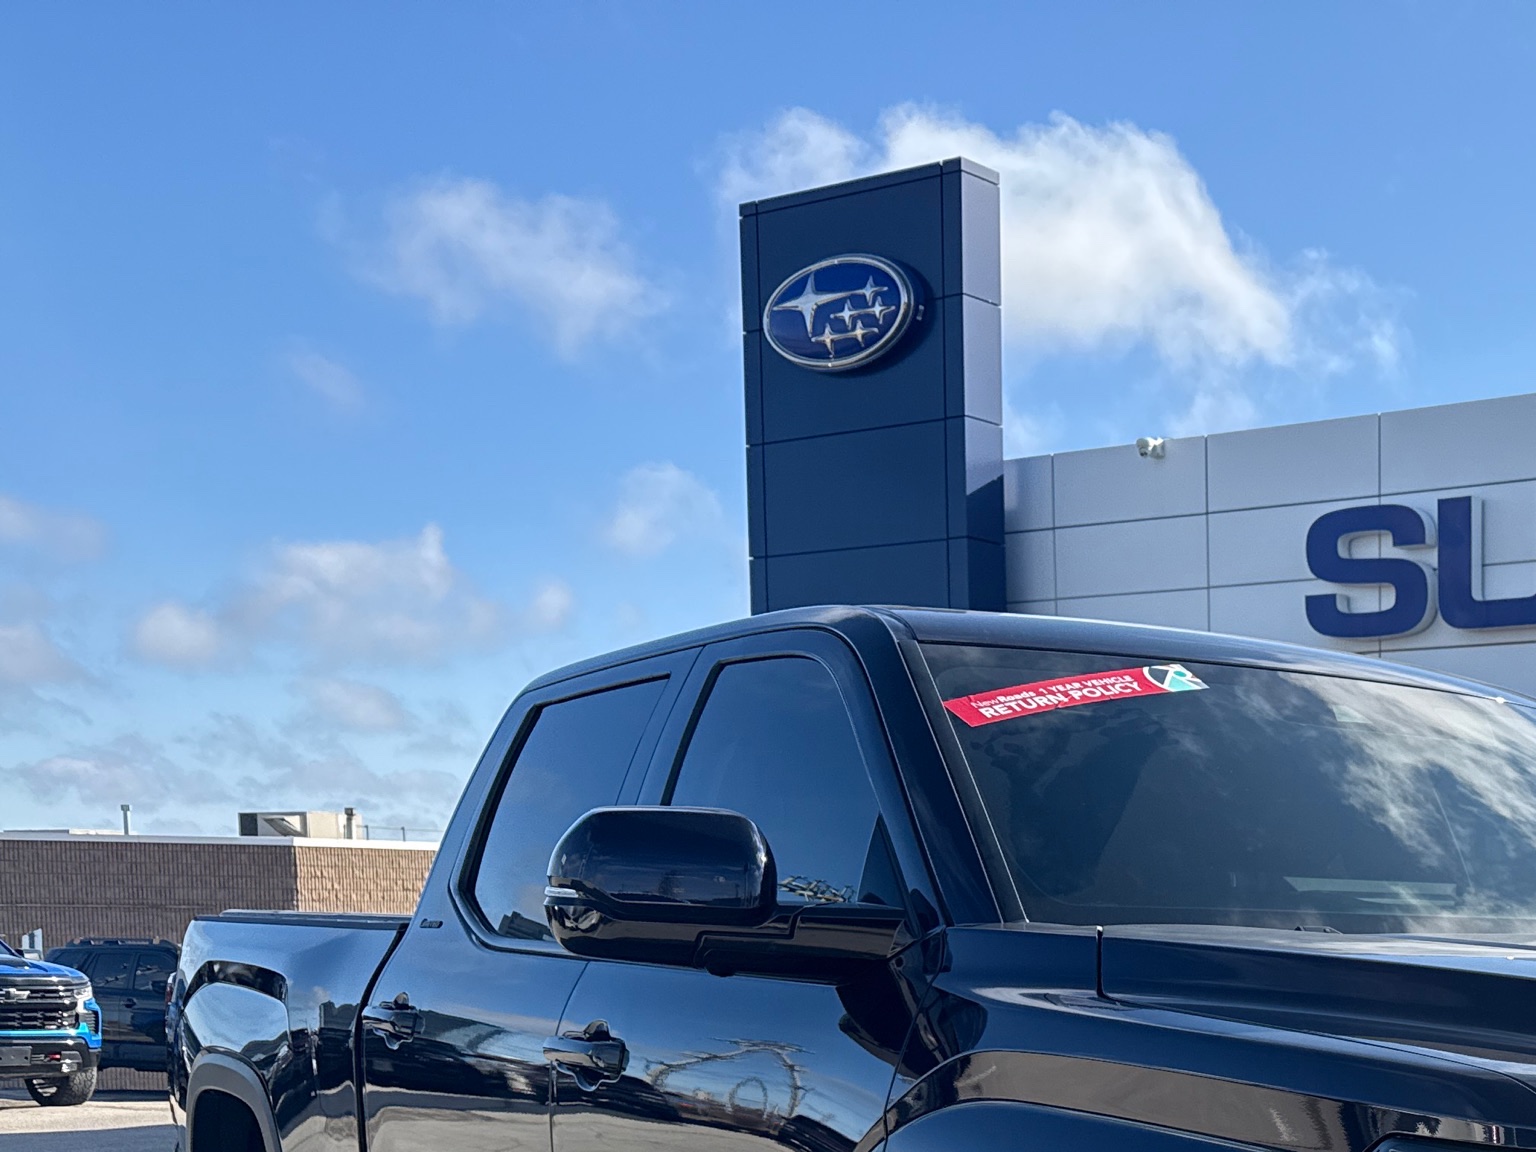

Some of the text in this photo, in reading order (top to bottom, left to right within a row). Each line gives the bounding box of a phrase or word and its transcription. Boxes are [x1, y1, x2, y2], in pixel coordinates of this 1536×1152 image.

[1039, 687, 1047, 695] 1
[1047, 681, 1083, 693] YEAR
[1082, 675, 1134, 688] VEHICLE
[978, 682, 1142, 718] RETURN POLICY
